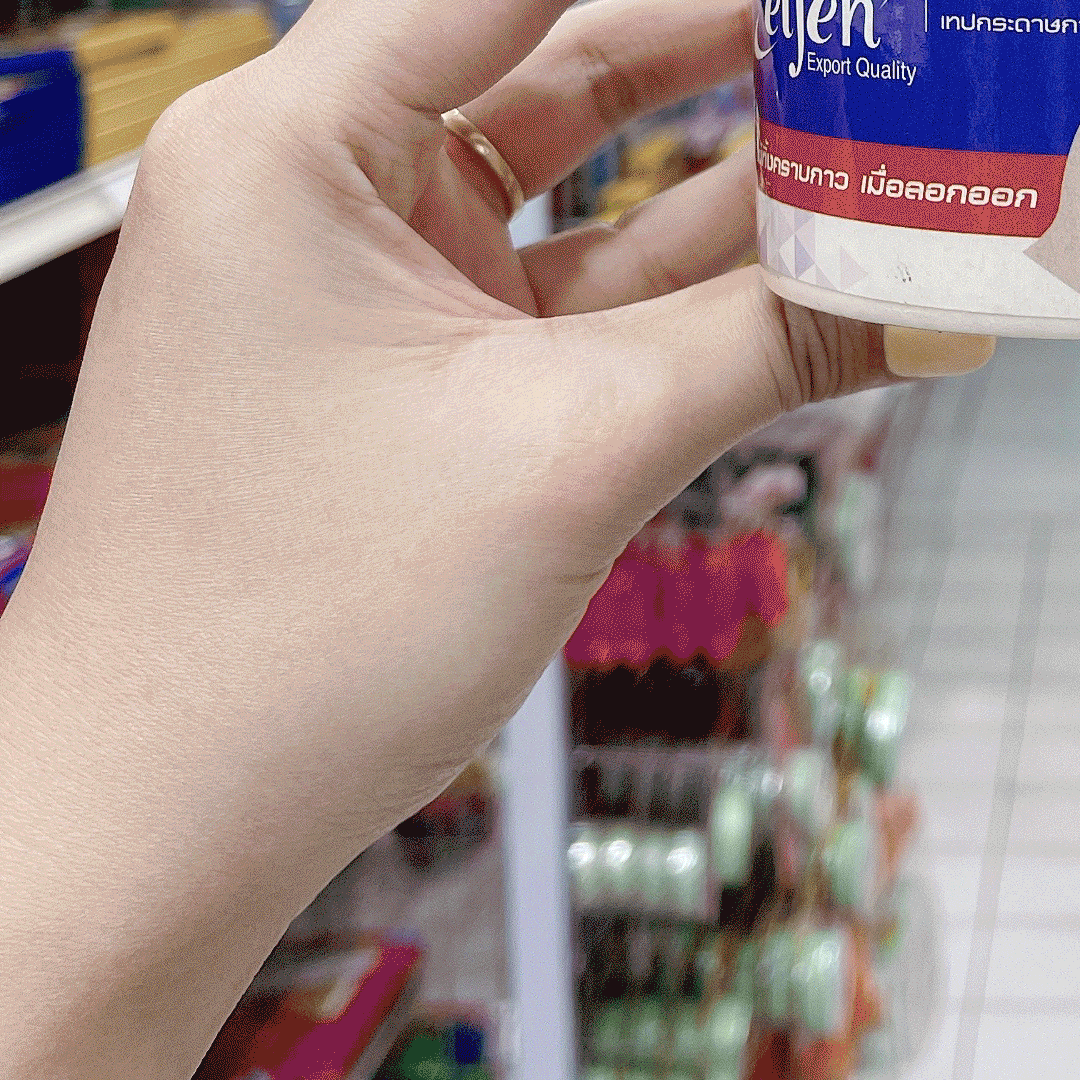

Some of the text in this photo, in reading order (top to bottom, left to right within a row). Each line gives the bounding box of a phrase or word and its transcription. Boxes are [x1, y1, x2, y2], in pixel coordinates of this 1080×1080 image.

[806, 51, 917, 87] Export Quality
[860, 163, 1039, 209] เมื่อลอกออก
